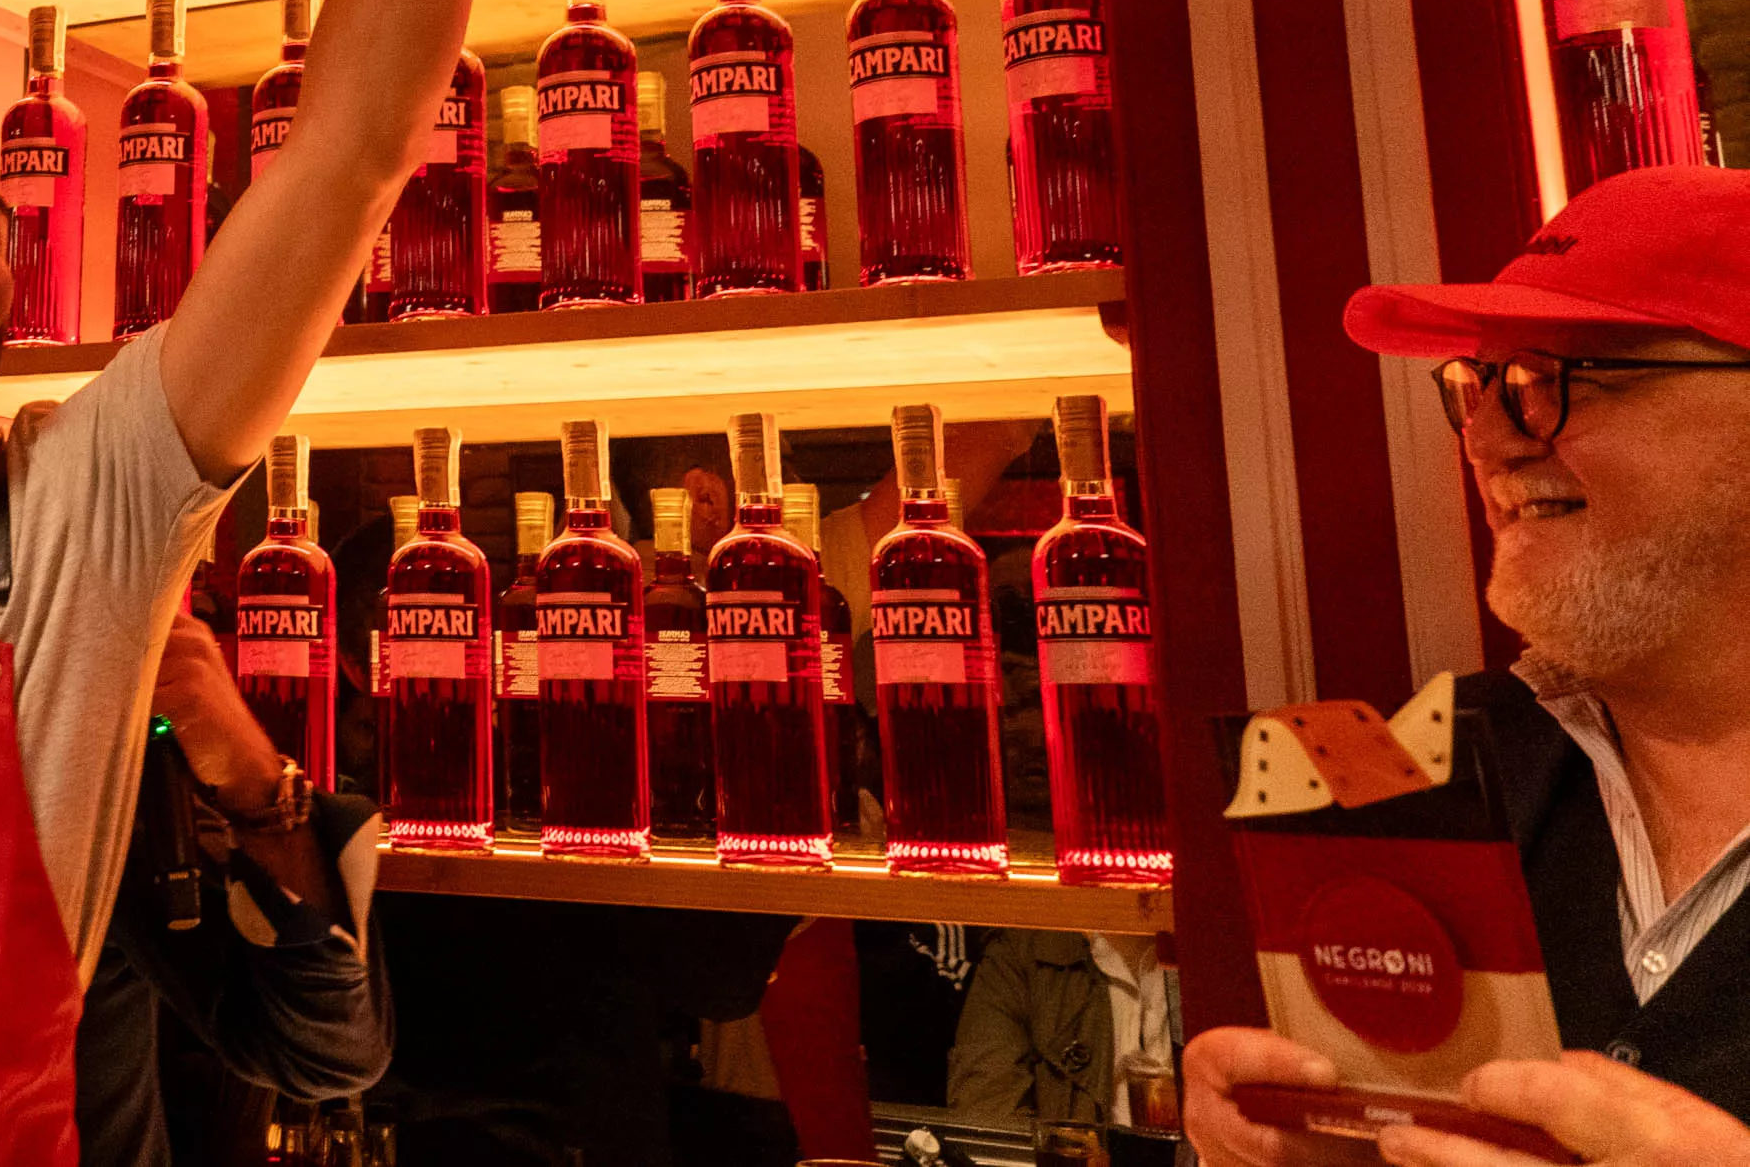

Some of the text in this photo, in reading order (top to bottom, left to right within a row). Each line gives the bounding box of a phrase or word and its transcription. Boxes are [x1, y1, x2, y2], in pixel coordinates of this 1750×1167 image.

[690, 65, 777, 101] AMPARI
[538, 85, 620, 116] AMPARI
[238, 609, 318, 637] AMPARI
[388, 608, 474, 637] AMPARI
[536, 608, 622, 636] AMPARI
[707, 608, 795, 636] AMPARI
[1314, 943, 1435, 977] NEGRONI
